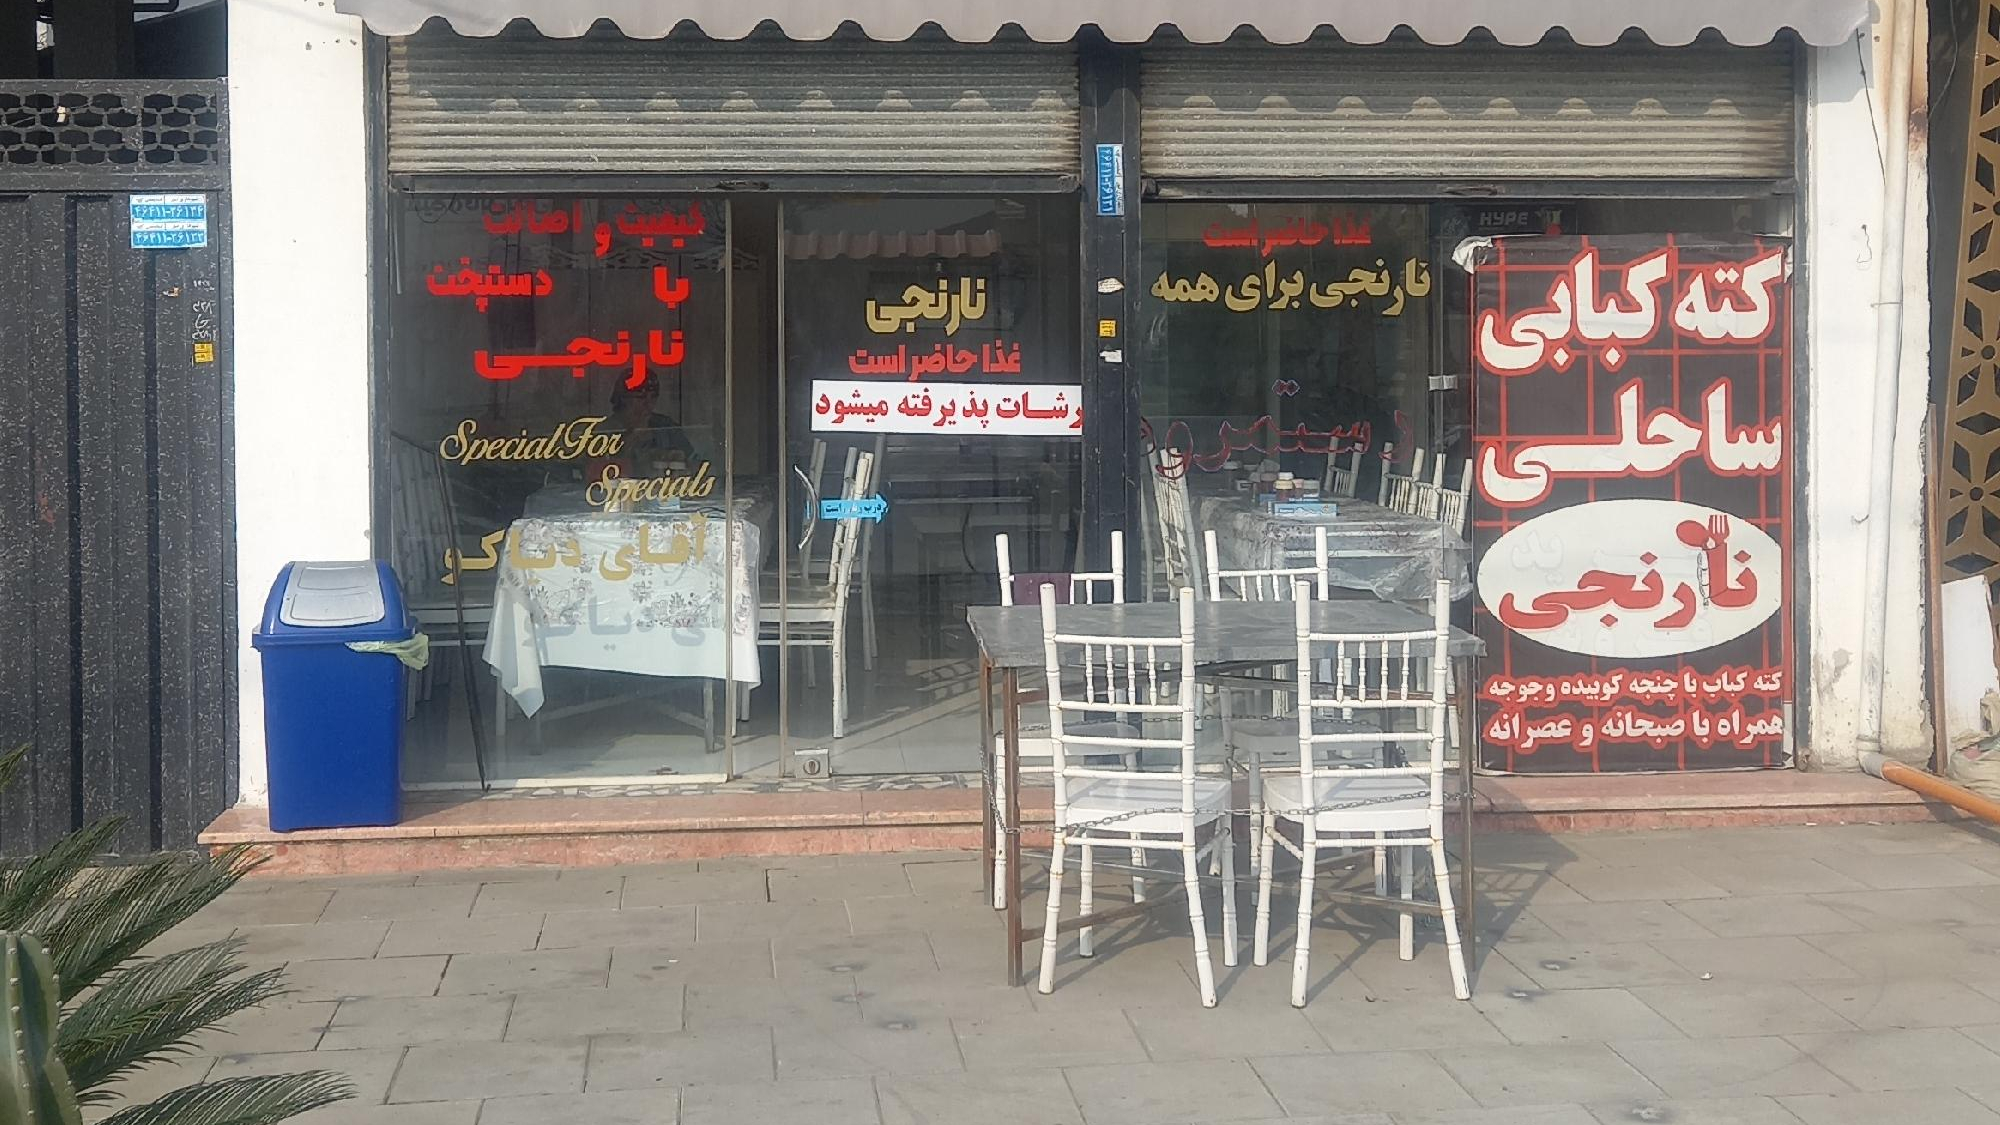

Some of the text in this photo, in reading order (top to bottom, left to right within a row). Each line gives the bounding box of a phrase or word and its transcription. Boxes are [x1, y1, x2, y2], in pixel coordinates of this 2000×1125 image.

[483, 200, 583, 234] اصالت
[616, 203, 706, 247] کیفیت
[1202, 211, 1373, 258] غذا حاضر است
[1479, 210, 1529, 226] HYPE
[594, 222, 612, 258] و
[426, 256, 554, 312] دستپخت
[865, 274, 987, 337] نارنجی
[1150, 257, 1432, 317] نارنجی برای همه
[1480, 251, 1783, 370] کته کبابی
[474, 329, 686, 390] نارنجی
[848, 340, 1022, 381] غذا حاضر است
[439, 415, 624, 466] Special For
[1482, 382, 1782, 502] ساحلی
[585, 461, 717, 513] Specials
[1498, 530, 1758, 631] نارنجی
[1560, 673, 1623, 701] کوبیده
[1683, 671, 1698, 698] با
[1702, 670, 1748, 698] کباب
[1752, 671, 1783, 692] کته
[1488, 708, 1784, 749] همراه با صبحانه و عصرانه
